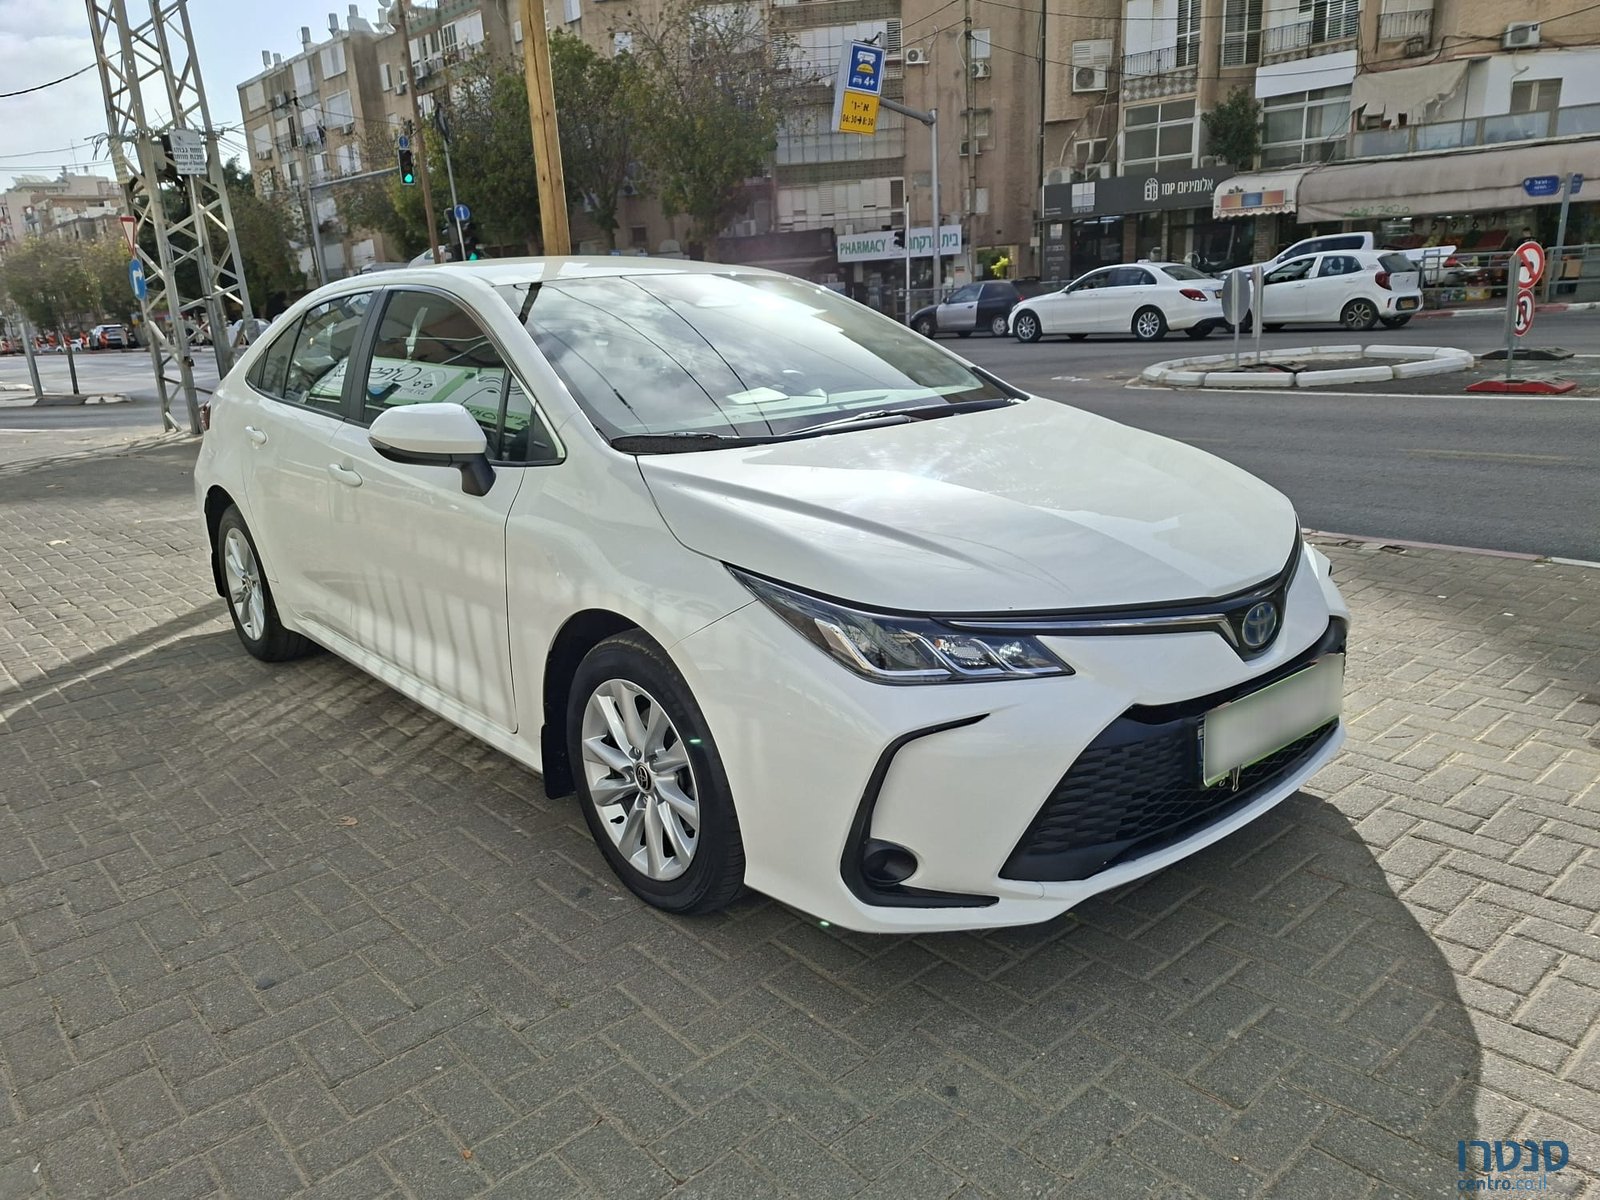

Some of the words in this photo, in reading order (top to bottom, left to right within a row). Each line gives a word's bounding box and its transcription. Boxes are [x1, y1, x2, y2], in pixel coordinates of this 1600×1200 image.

[1177, 177, 1214, 194] אלומיניום
[840, 238, 887, 254] PHARMACY
[941, 232, 959, 248] בית
